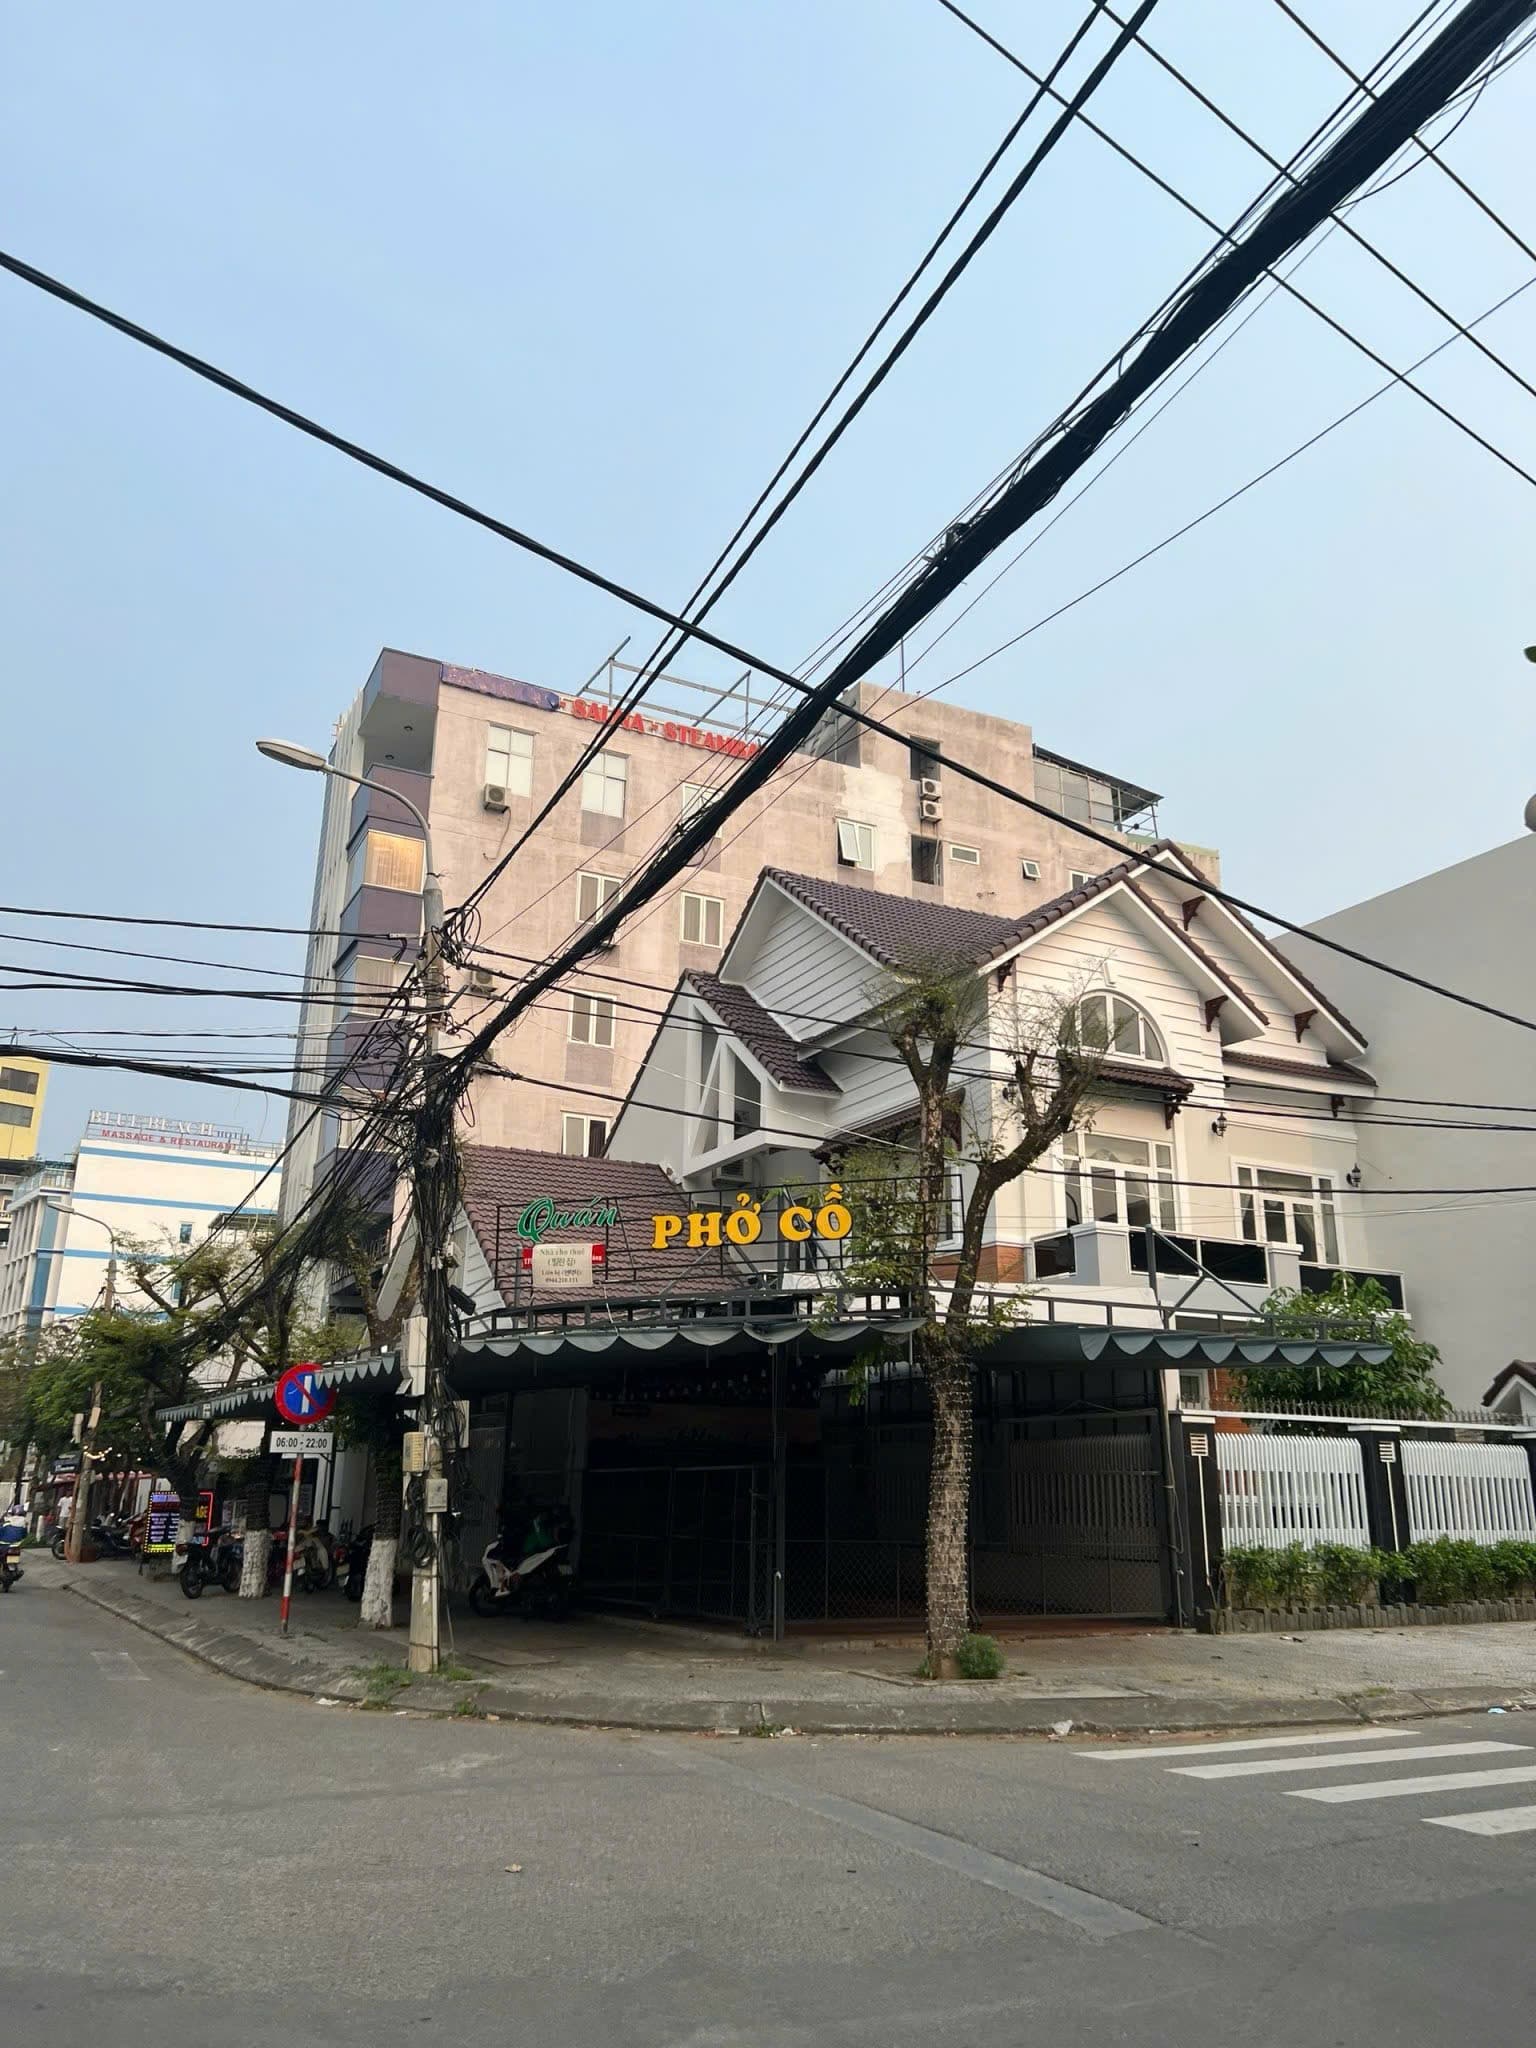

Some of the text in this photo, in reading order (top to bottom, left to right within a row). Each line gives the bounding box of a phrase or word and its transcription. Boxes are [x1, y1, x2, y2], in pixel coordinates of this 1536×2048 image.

[148, 1116, 214, 1136] BEACH
[101, 1129, 238, 1151] MASSAGE & RESTAURANT
[516, 1194, 618, 1244] Quán
[651, 1192, 762, 1250] PHỞ
[276, 1437, 298, 1448] 06:00
[305, 1438, 328, 1449] 22:00
